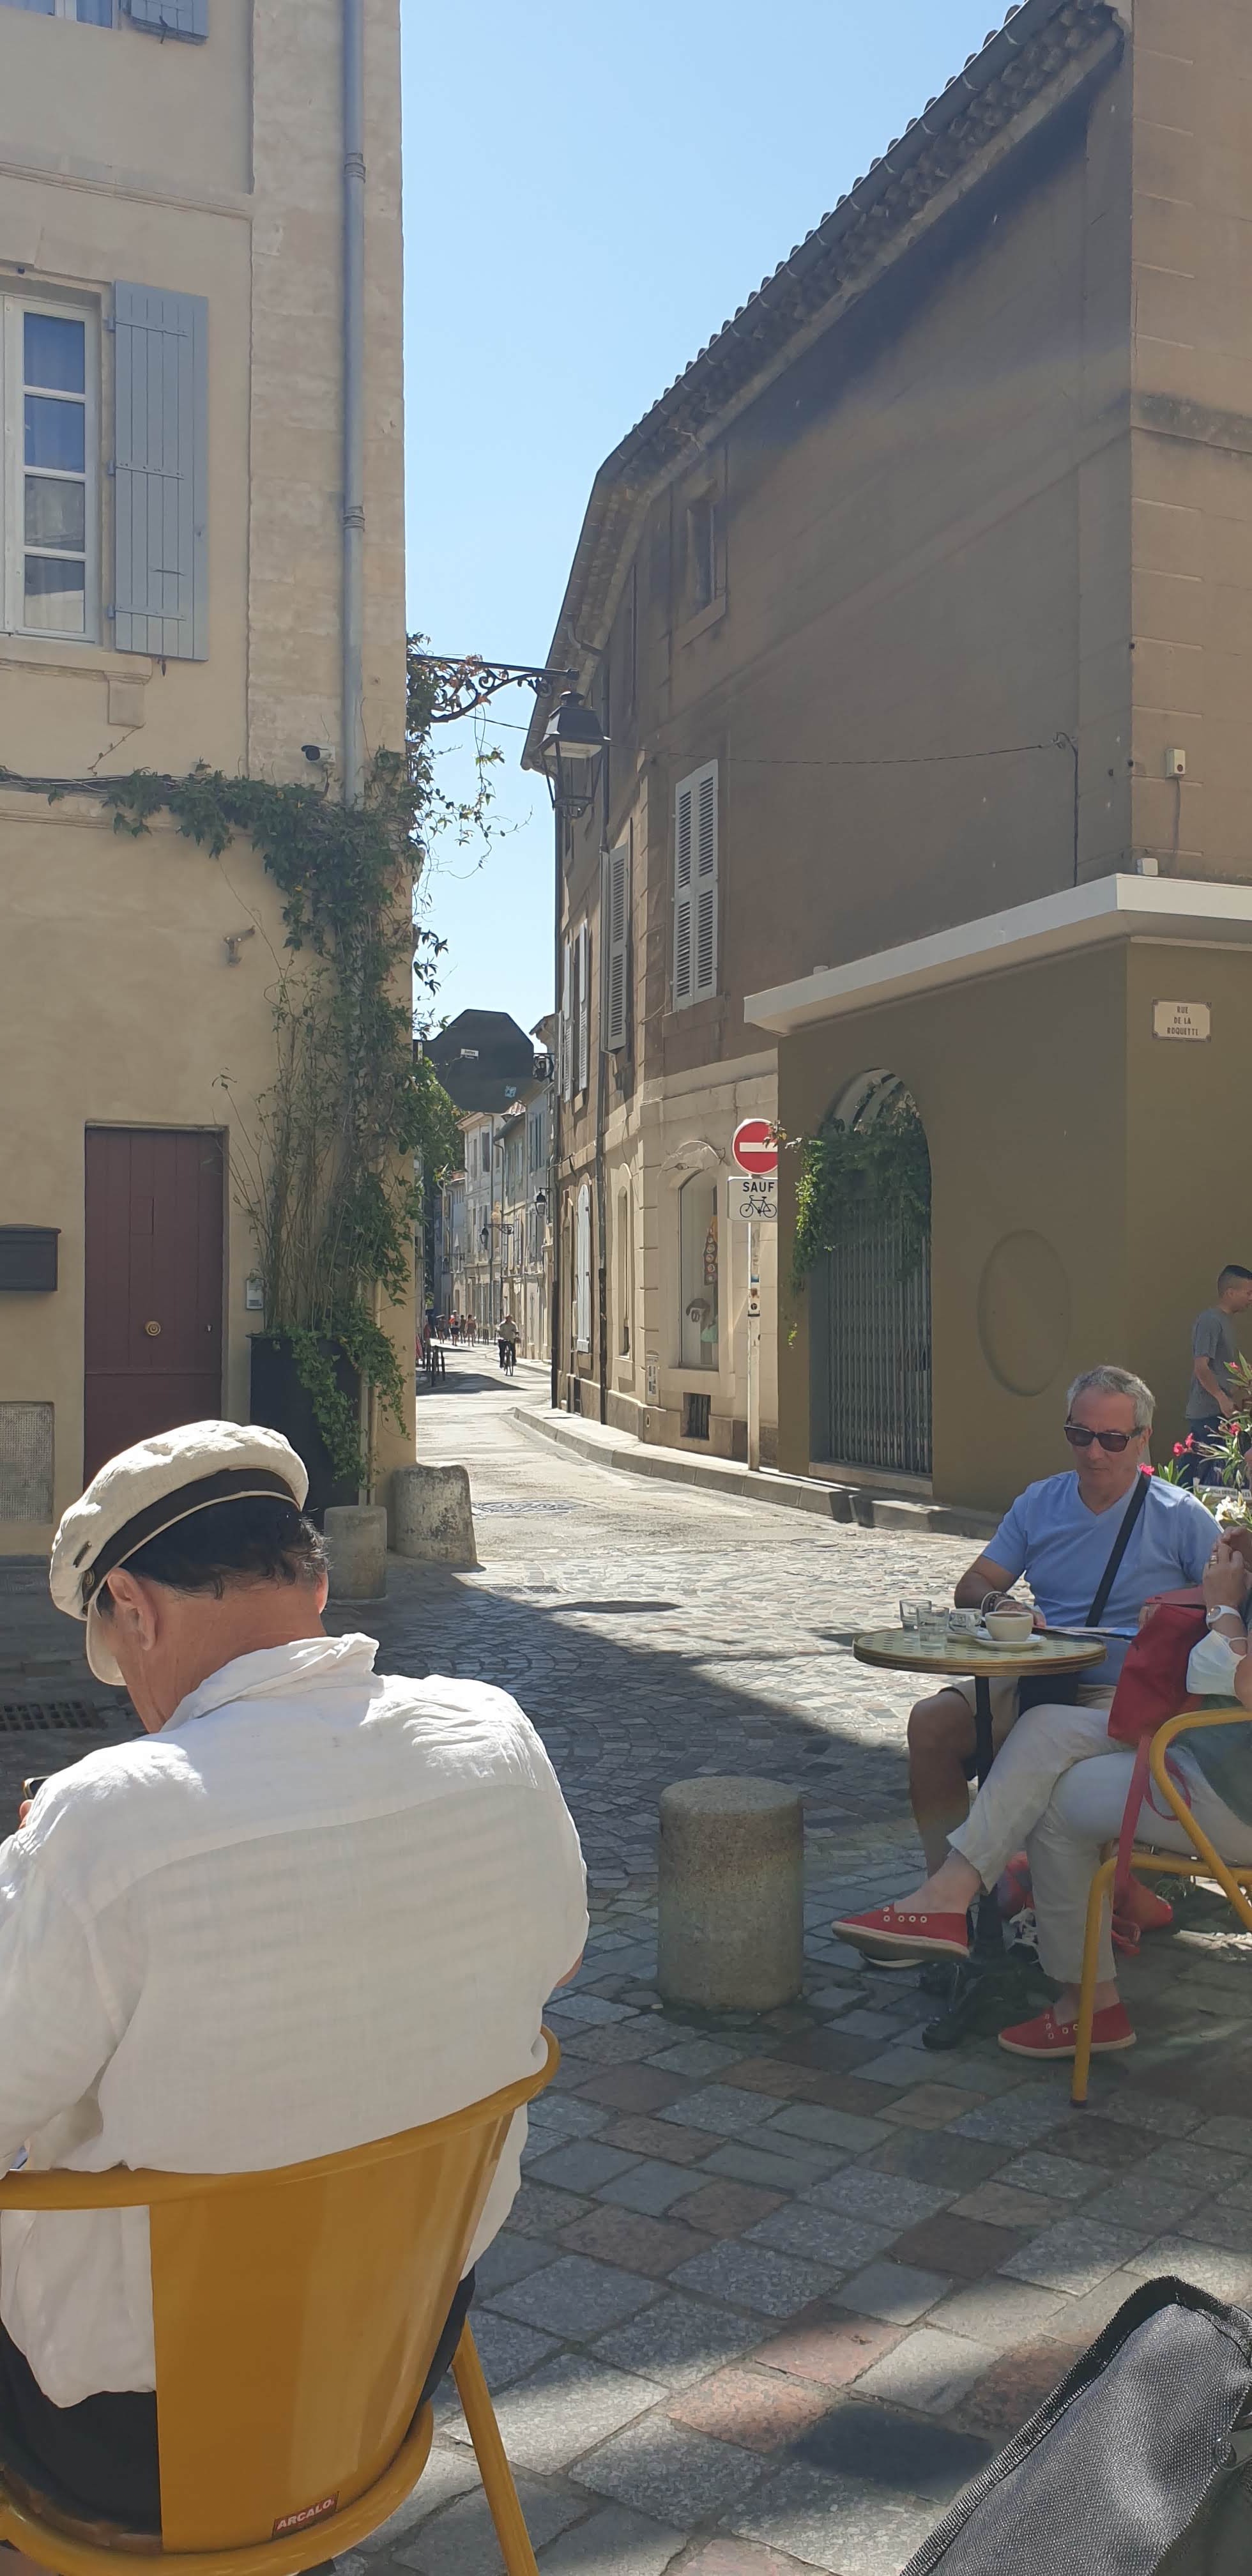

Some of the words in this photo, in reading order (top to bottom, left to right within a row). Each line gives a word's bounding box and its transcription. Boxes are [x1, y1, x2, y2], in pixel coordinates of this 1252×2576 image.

[1177, 1006, 1188, 1014] RUE
[1167, 1027, 1198, 1036] ROQUETTE
[742, 1182, 774, 1192] SAUF
[277, 2499, 332, 2530] ARCALO
